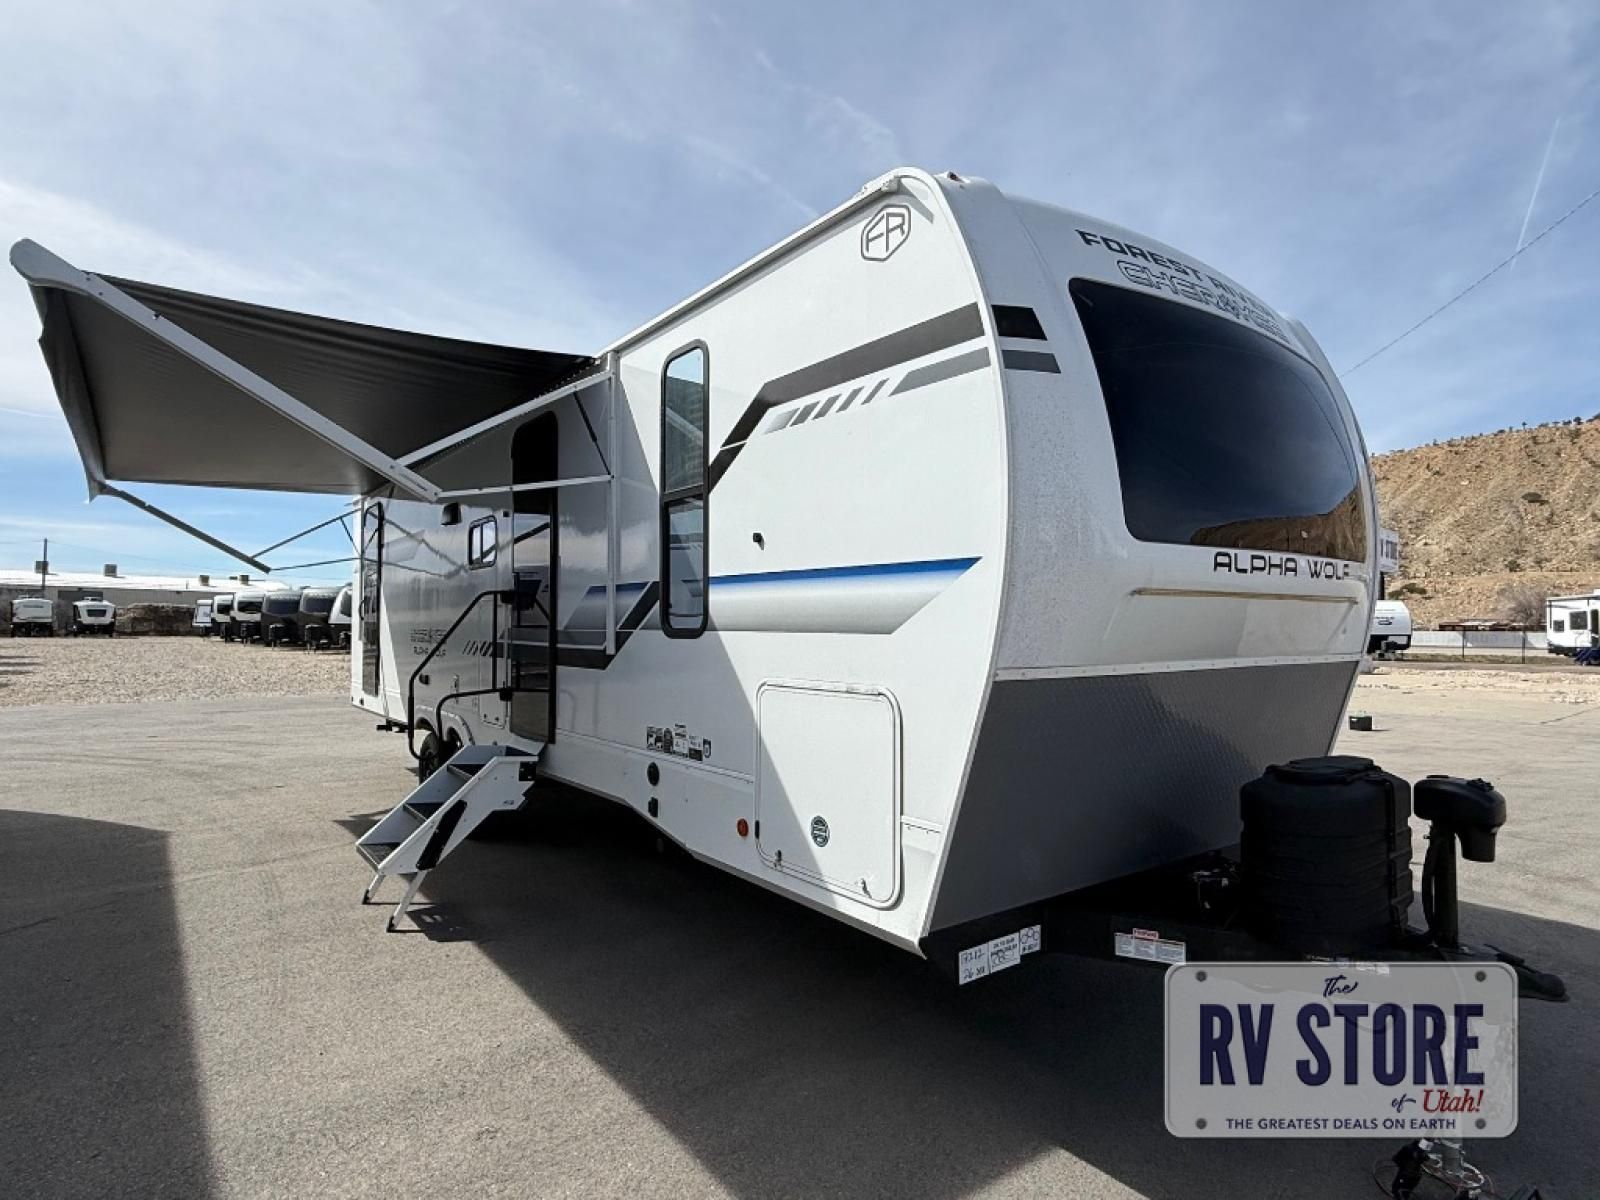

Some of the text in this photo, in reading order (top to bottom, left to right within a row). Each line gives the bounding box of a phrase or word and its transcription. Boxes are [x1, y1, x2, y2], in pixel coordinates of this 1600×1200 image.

[1075, 229, 1203, 281] FOREST
[1213, 551, 1350, 581] ALPHA WOLF
